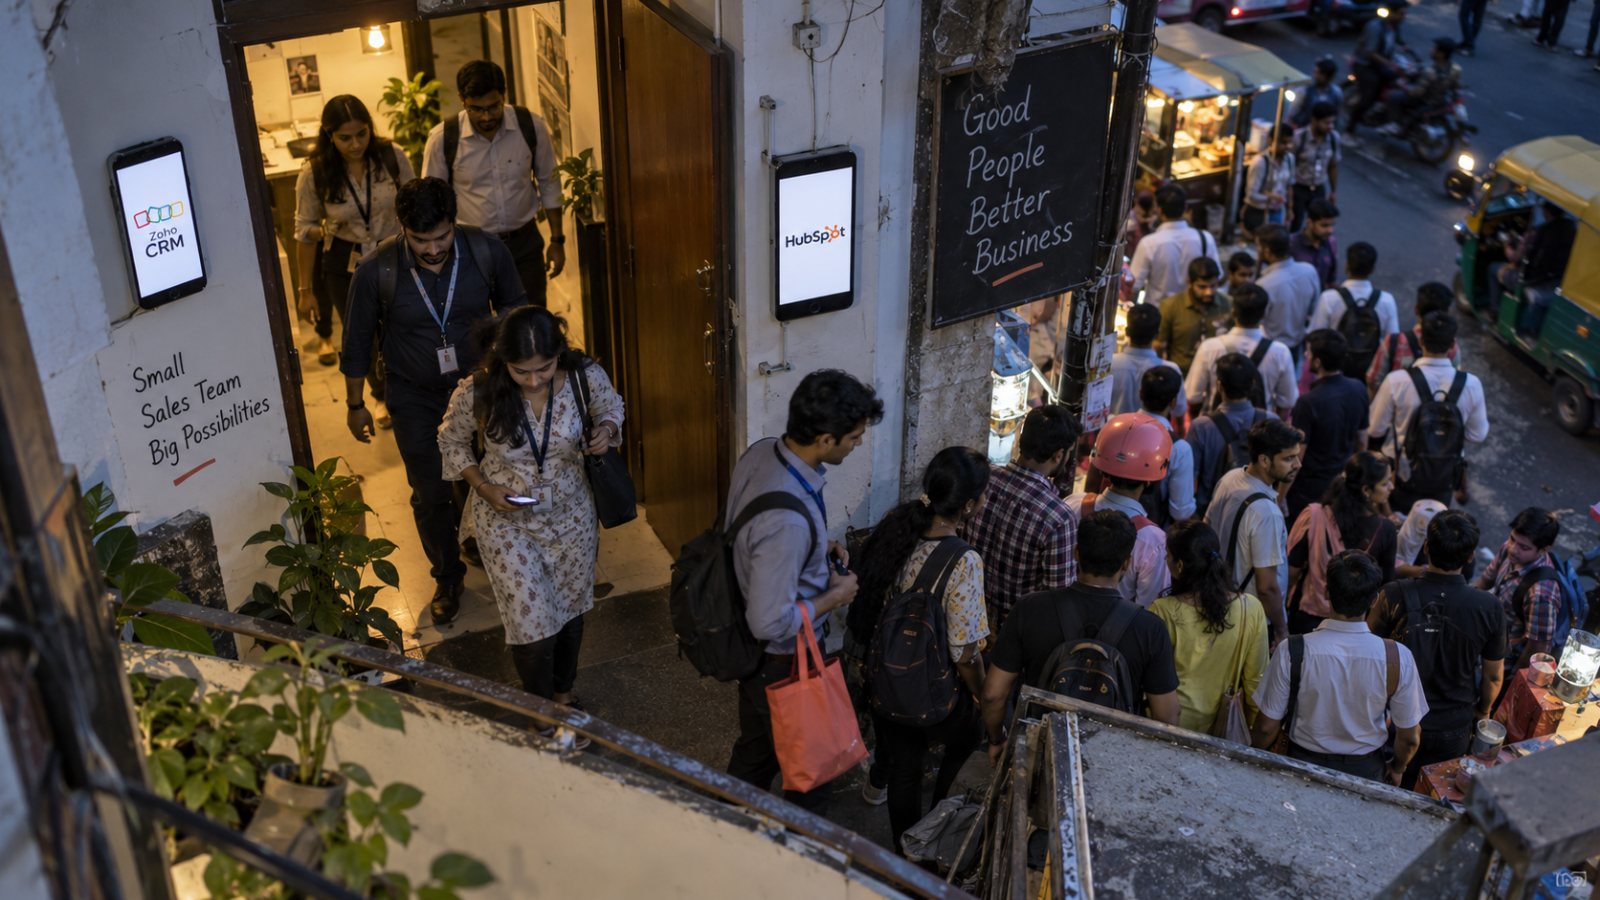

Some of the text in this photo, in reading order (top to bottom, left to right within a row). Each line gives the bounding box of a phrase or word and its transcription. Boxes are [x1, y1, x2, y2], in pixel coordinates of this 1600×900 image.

[963, 84, 1032, 136] Good
[966, 132, 1045, 188] People
[149, 226, 178, 241] Zoho
[966, 187, 1050, 235] Better
[145, 234, 185, 258] CRM
[785, 225, 846, 248] HubSpot
[972, 221, 1073, 275] Business
[132, 351, 185, 393] Small
[141, 375, 241, 429] Sales Team
[148, 398, 270, 466] Big Possibilities
